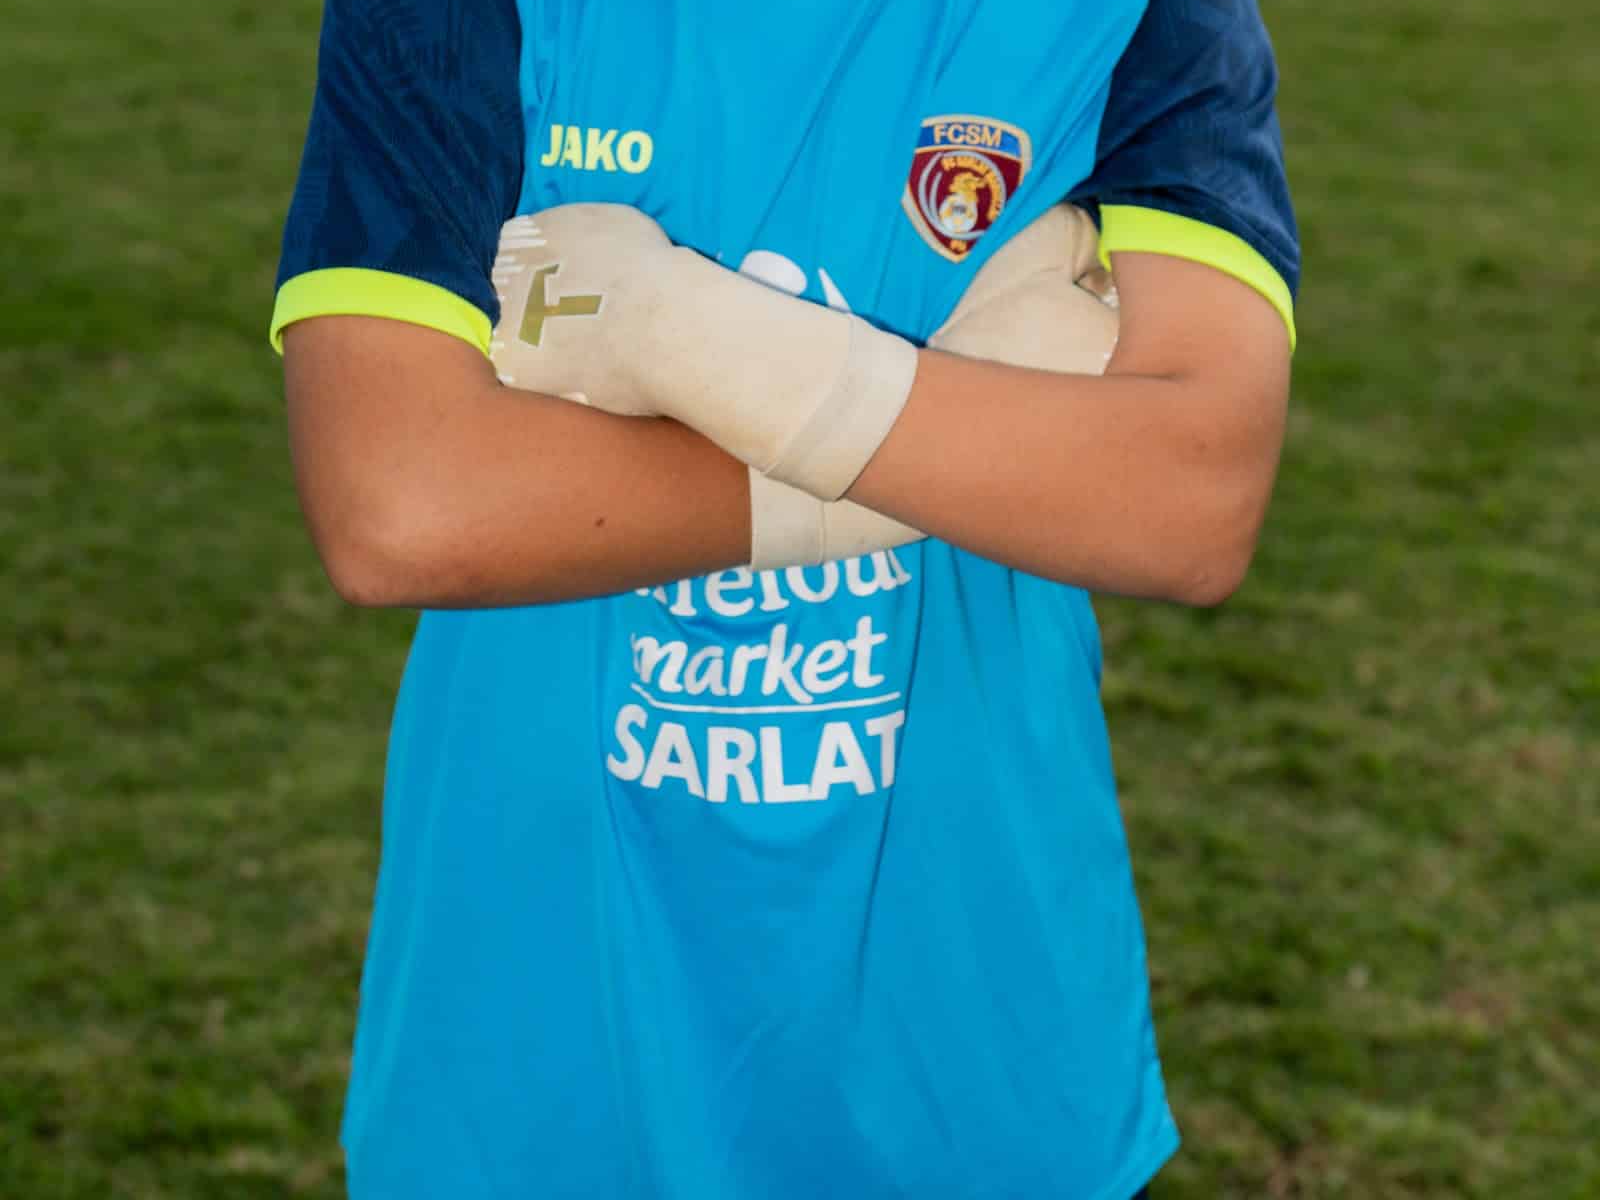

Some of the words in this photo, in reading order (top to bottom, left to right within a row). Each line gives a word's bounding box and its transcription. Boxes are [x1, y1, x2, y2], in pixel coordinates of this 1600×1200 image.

[541, 124, 653, 174] JAKO
[933, 124, 1003, 147] FCSM
[630, 615, 889, 704] market
[607, 703, 905, 804] SARLAT
